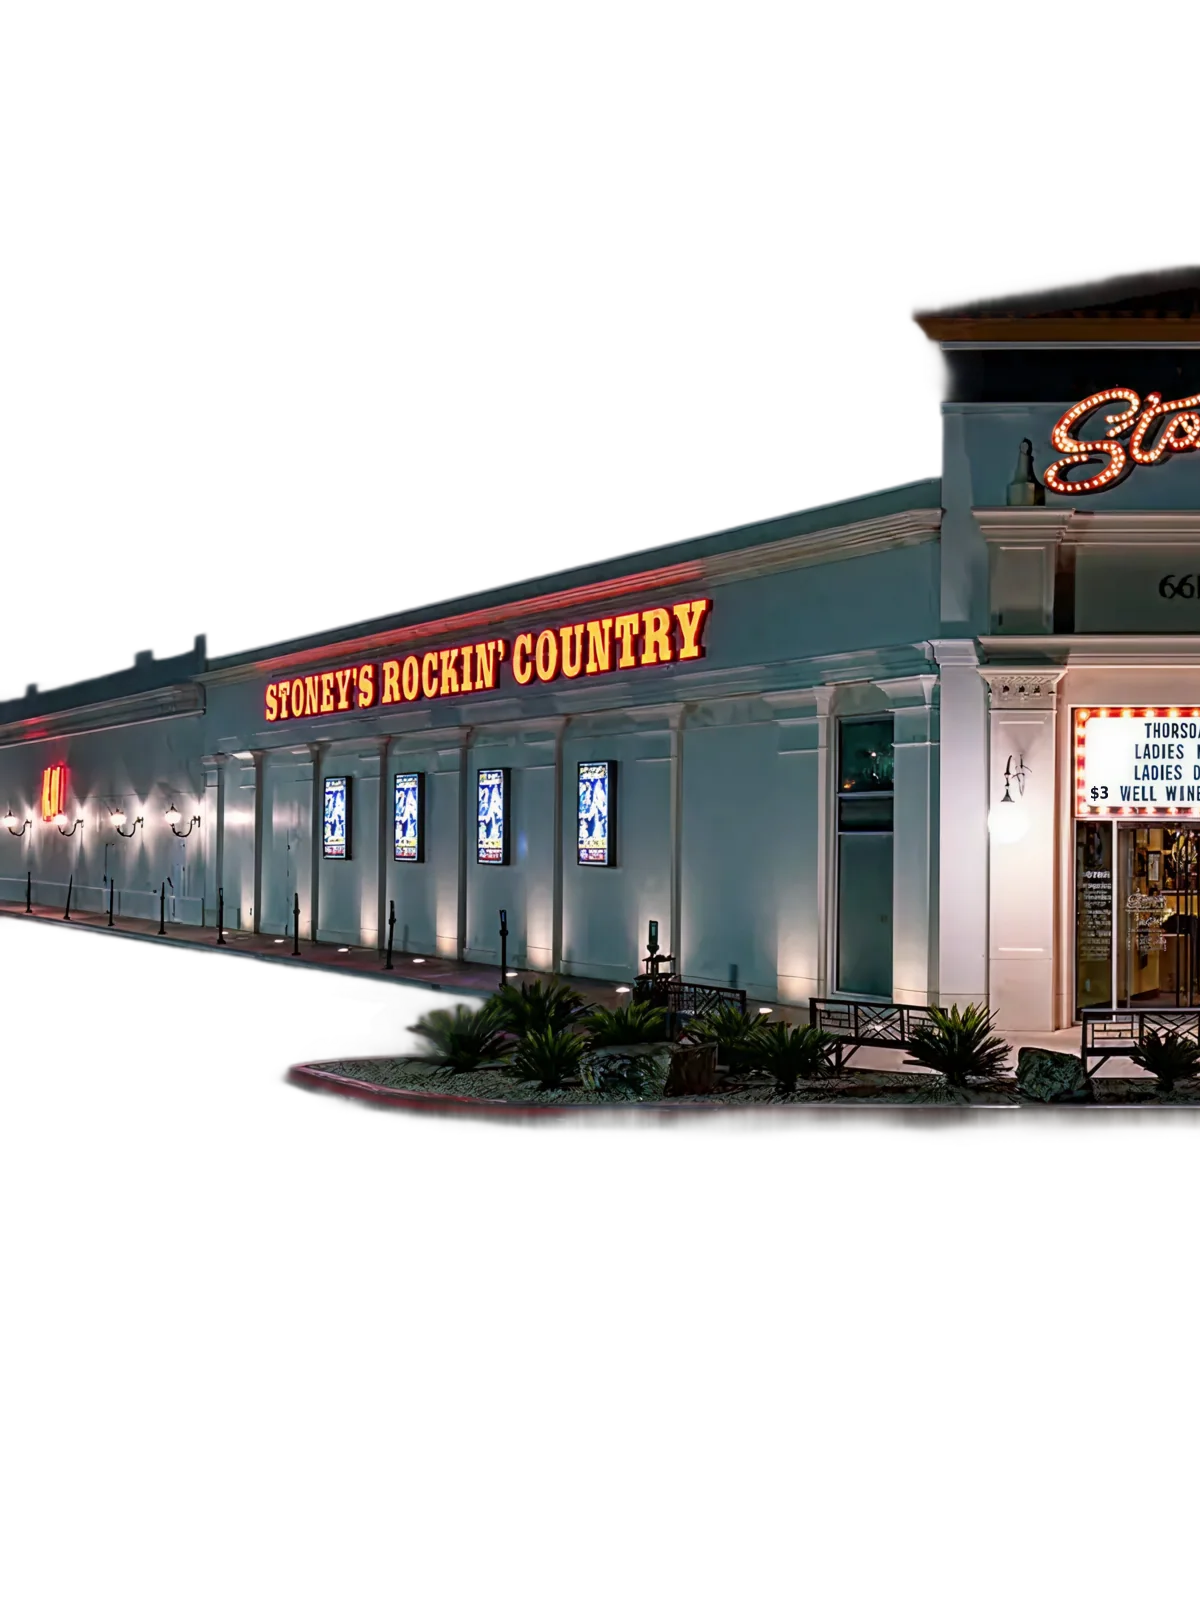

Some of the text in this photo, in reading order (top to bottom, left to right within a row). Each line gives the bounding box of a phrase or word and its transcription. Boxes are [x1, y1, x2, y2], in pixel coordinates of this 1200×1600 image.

[265, 599, 710, 722] STONEY'S ROCKIN' COUNTRY
[1134, 743, 1185, 760] LADIES
[1133, 764, 1183, 781] LADIES
[1089, 785, 1109, 802] $3
[1119, 785, 1158, 802] WELL
